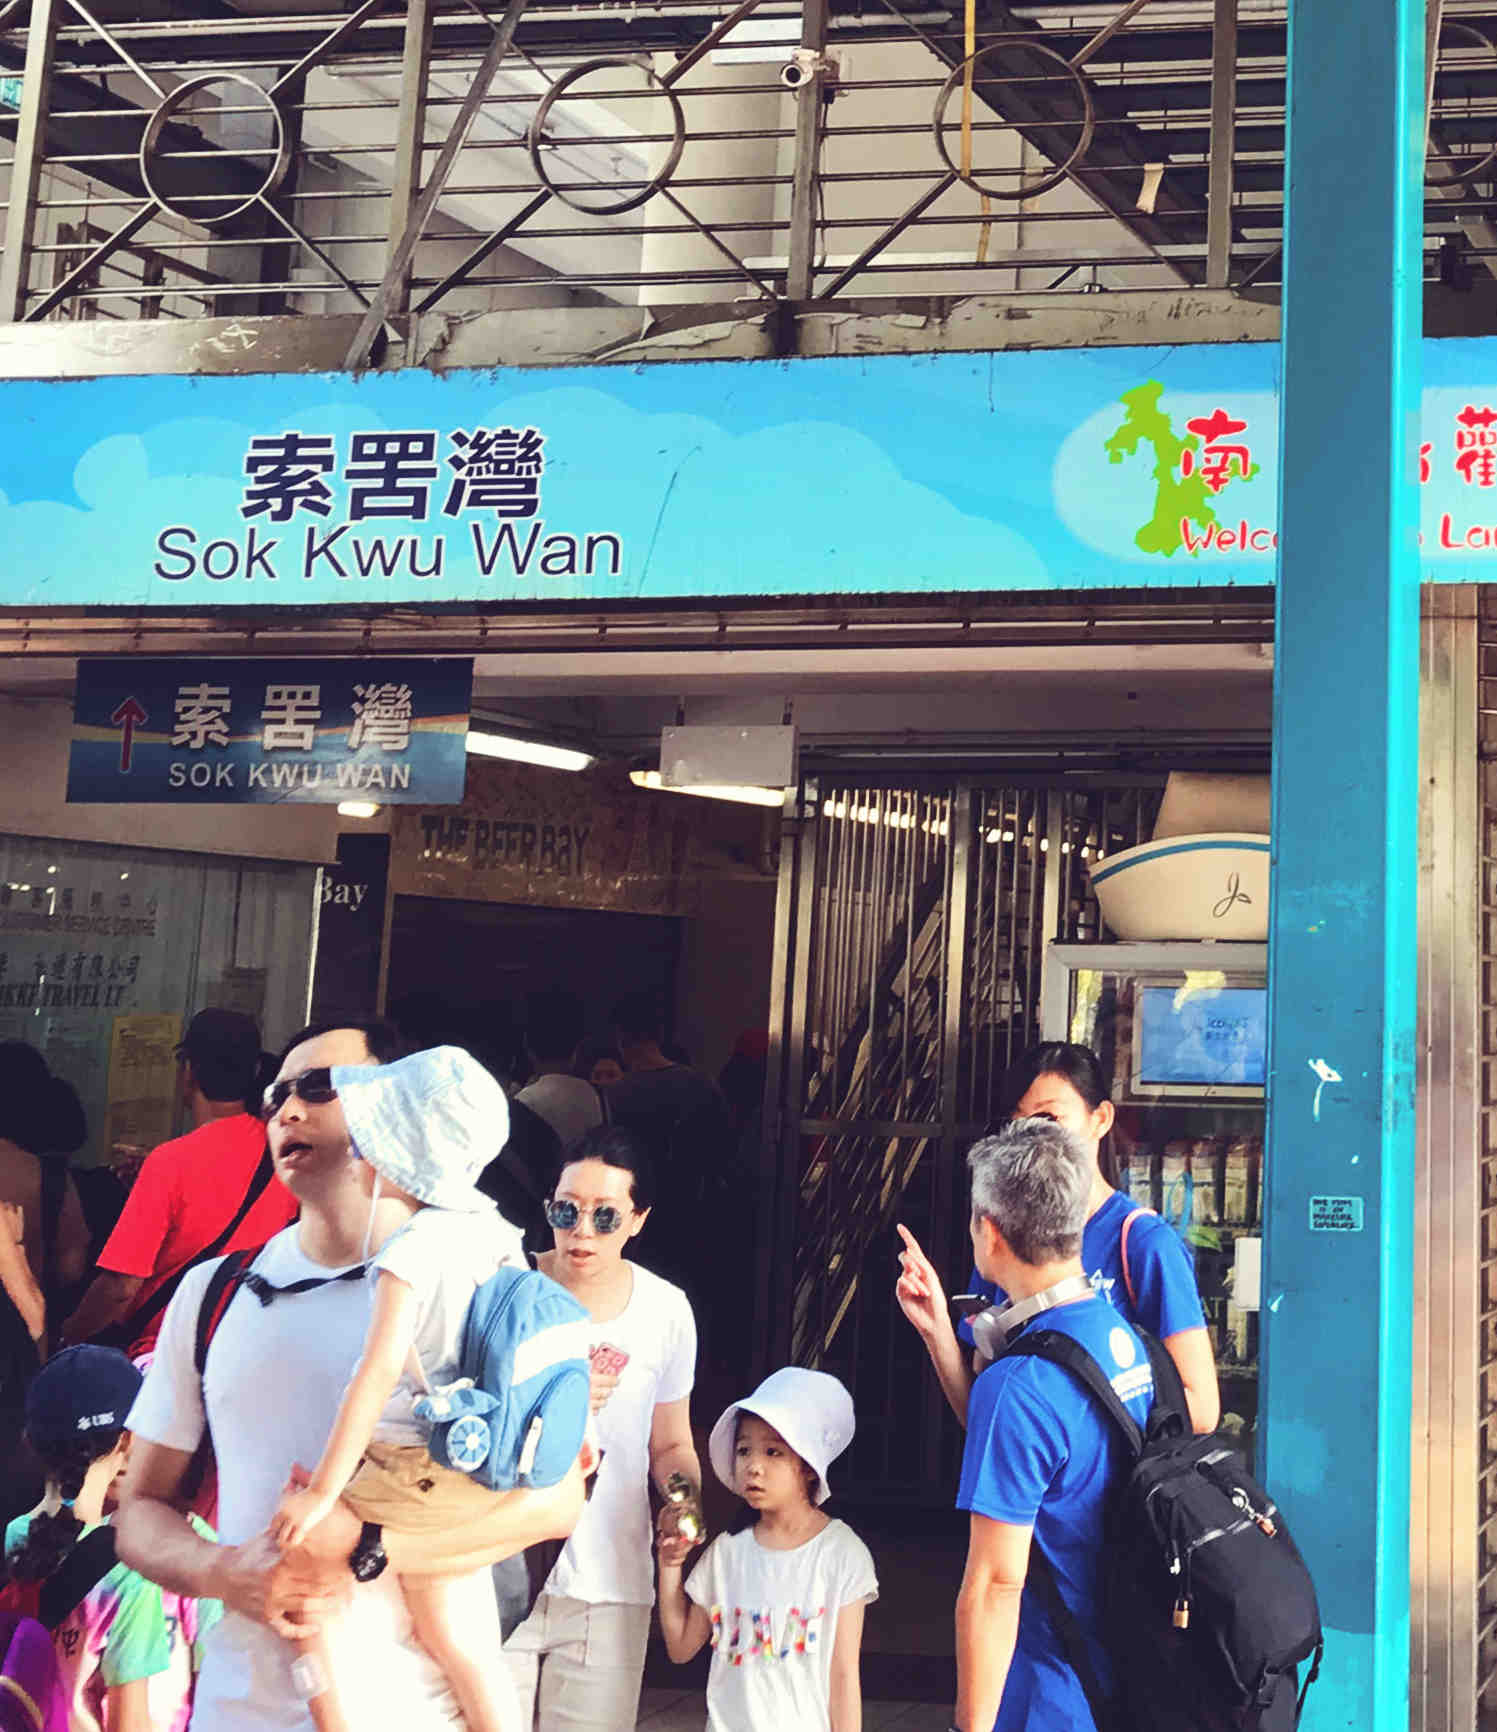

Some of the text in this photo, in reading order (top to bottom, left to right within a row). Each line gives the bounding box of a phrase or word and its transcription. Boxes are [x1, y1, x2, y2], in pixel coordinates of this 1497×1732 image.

[240, 428, 543, 523] 索罟灣
[154, 522, 621, 580] Sok Kwu Wan
[1182, 517, 1278, 551] Welc
[170, 683, 412, 751] 索罟灣
[169, 763, 411, 789] SOK KWU WAN
